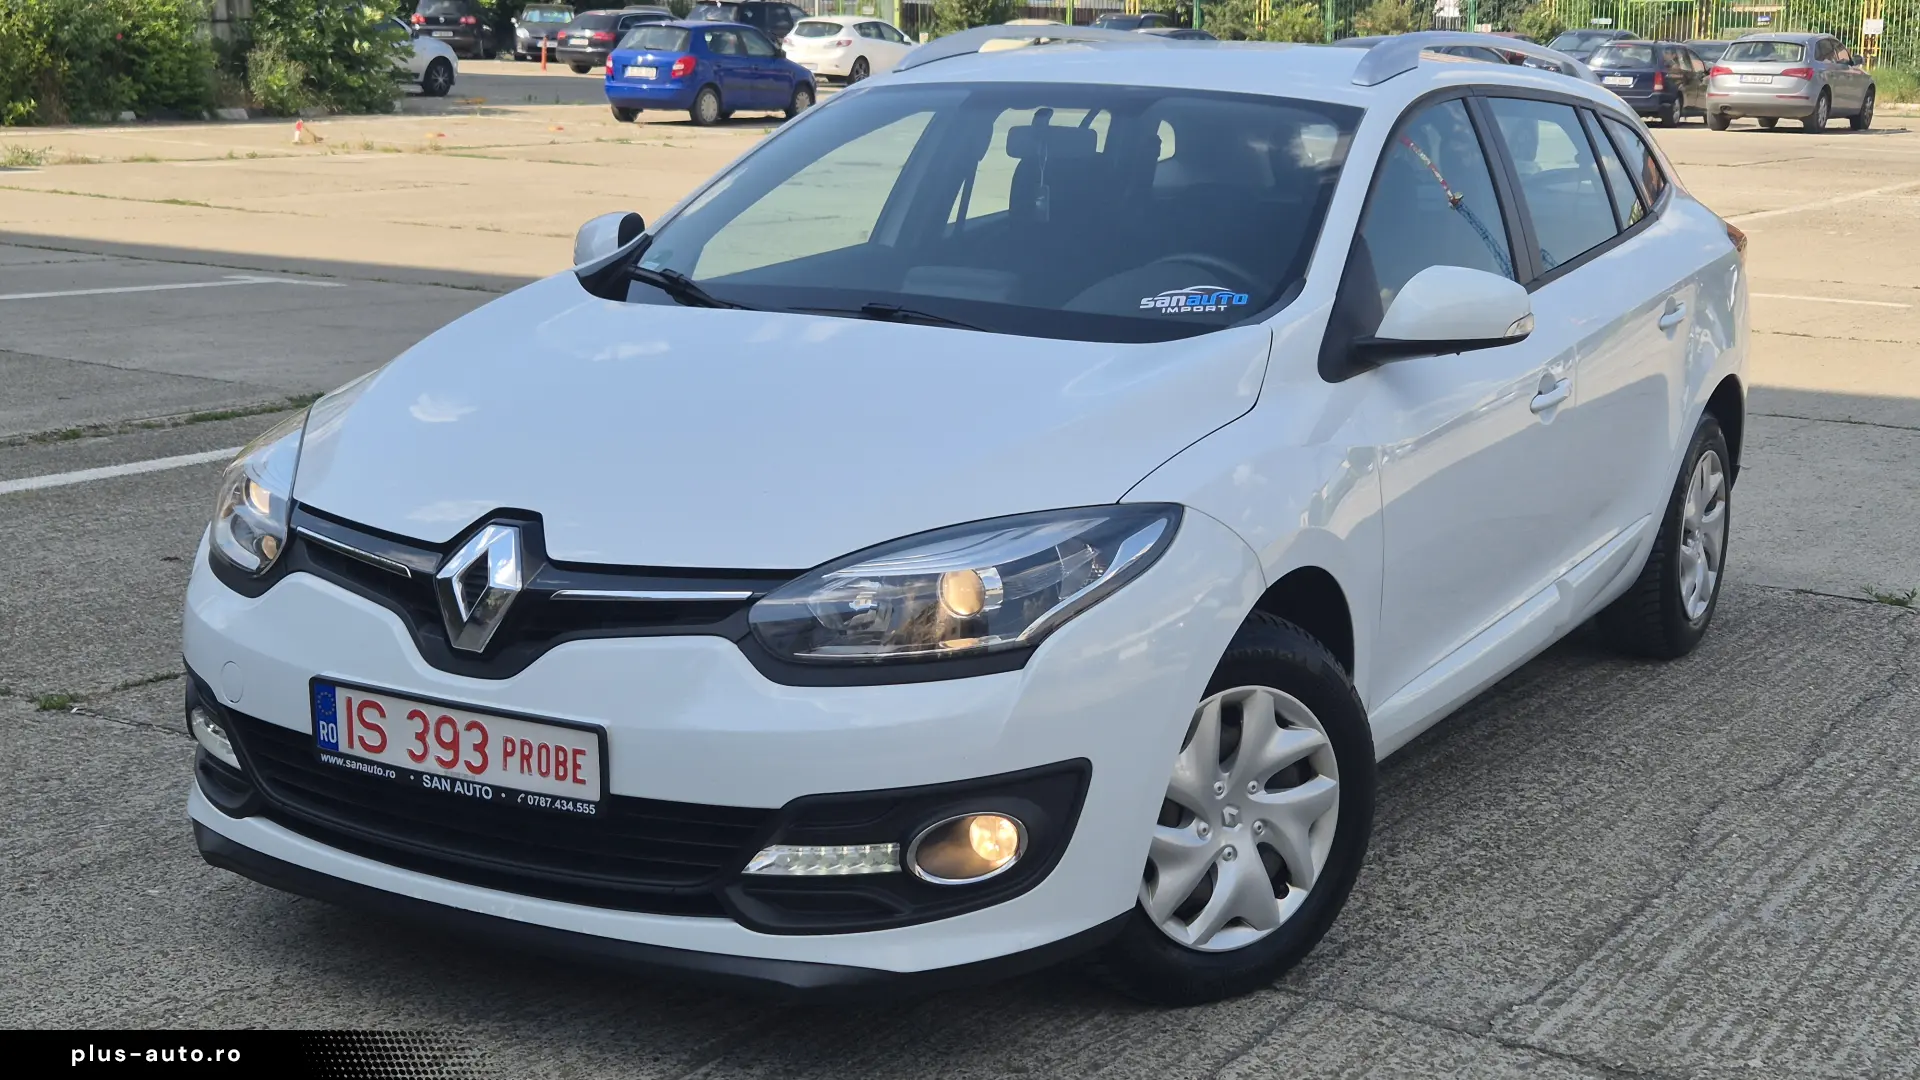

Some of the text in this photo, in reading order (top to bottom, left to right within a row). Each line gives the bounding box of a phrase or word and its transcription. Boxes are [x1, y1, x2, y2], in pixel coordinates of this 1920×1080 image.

[1161, 305, 1228, 314] IMPORT
[319, 720, 337, 744] RO
[346, 696, 587, 785] IS 393 PROBE
[320, 753, 396, 779] www.sanauto.ro
[422, 774, 451, 792] SAN
[454, 780, 493, 800] AUTO
[527, 794, 596, 815] 0787.434.555
